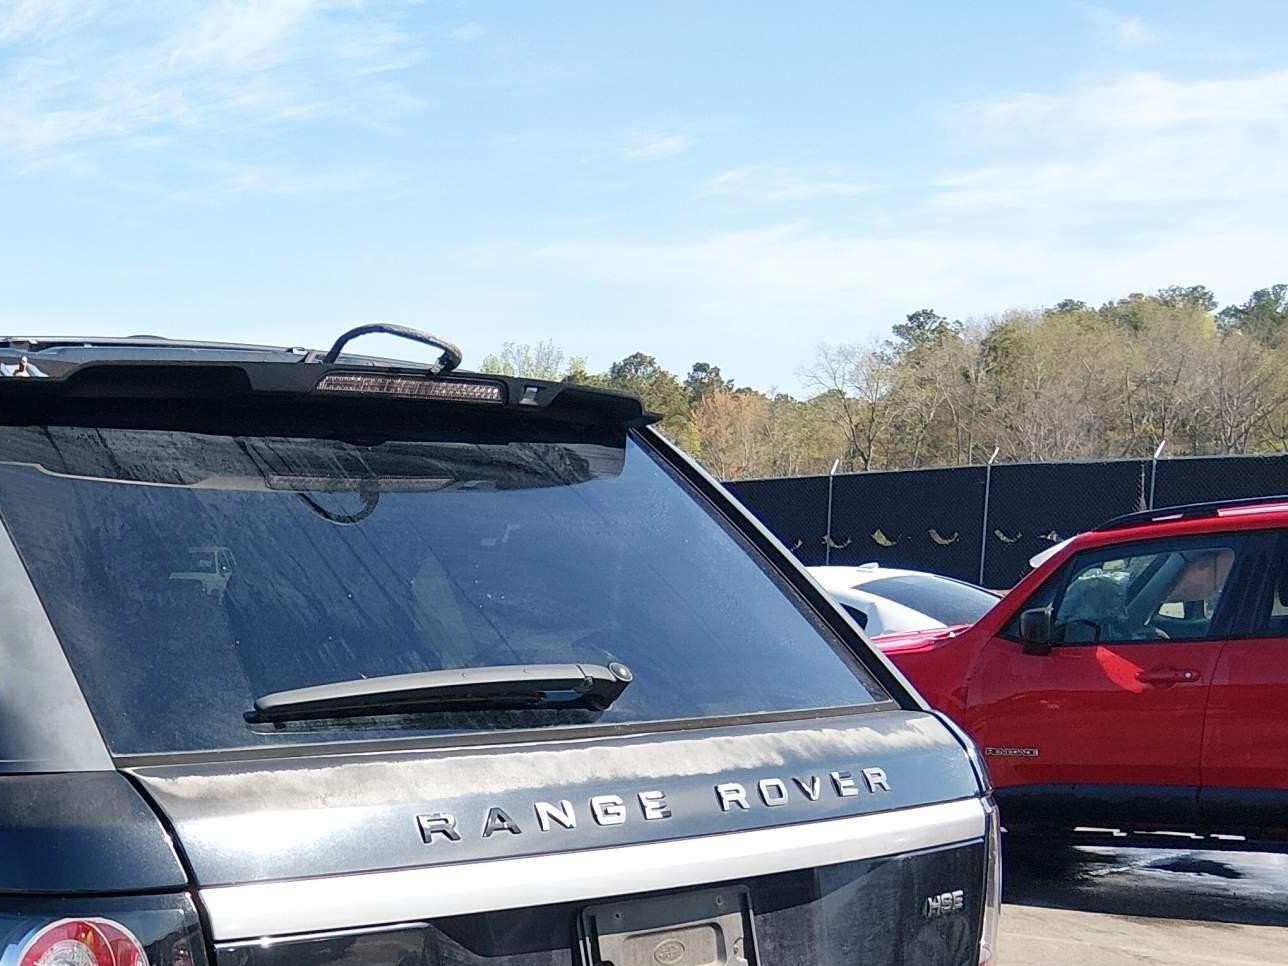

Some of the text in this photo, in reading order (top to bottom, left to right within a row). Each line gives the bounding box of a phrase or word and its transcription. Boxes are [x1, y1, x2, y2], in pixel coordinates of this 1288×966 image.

[415, 767, 891, 844] RANGE ROVER
[925, 889, 964, 917] HSE
